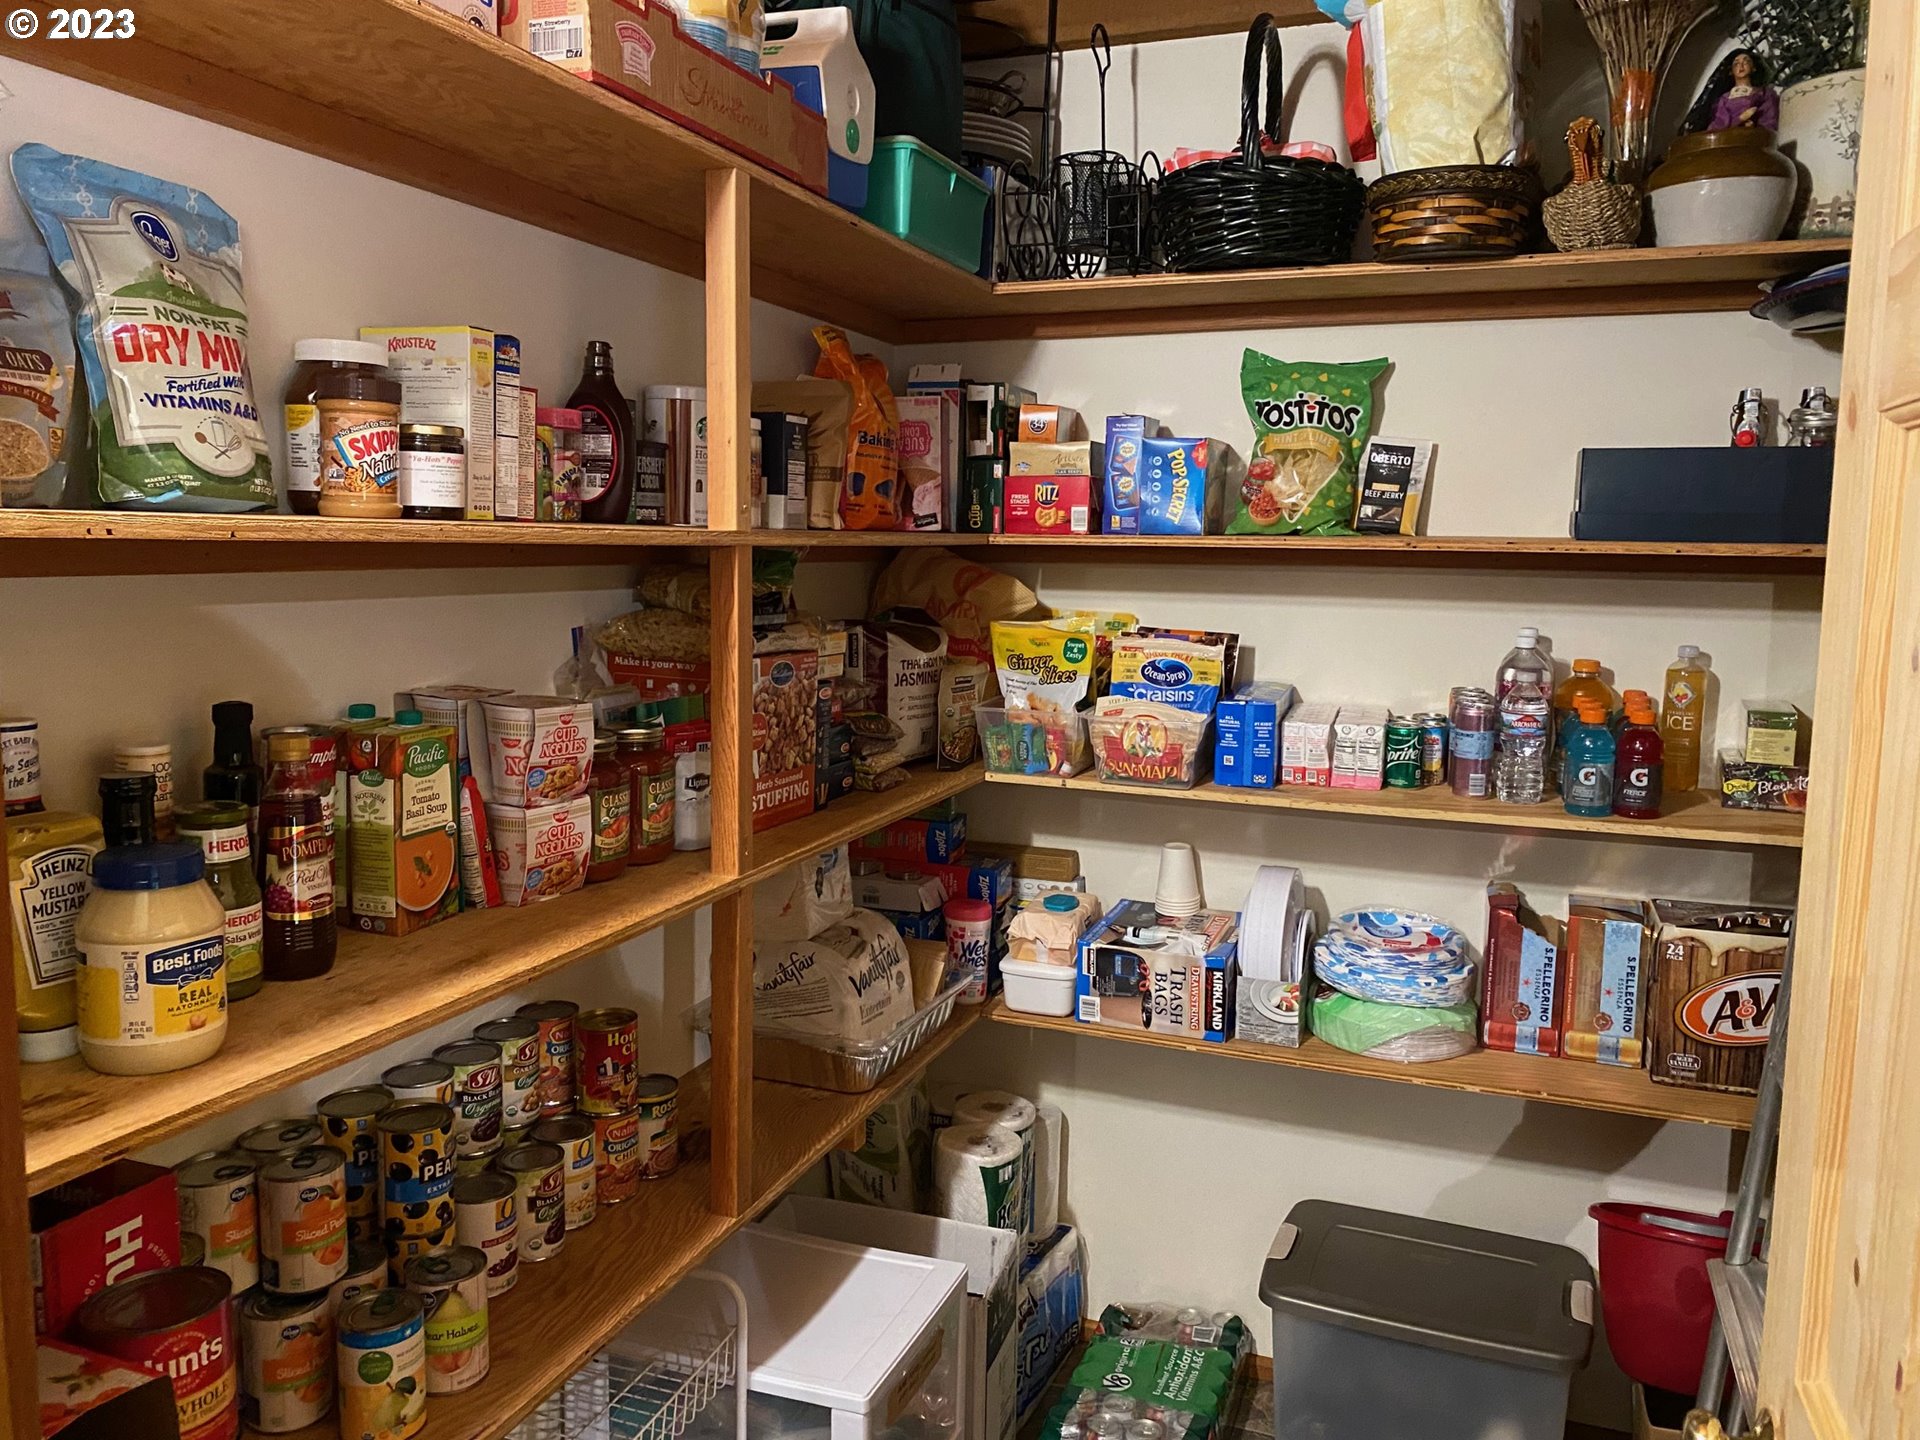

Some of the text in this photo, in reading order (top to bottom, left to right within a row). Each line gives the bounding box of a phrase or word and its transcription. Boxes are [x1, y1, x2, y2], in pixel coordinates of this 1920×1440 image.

[152, 305, 231, 333] NON-FAT
[112, 323, 189, 367] DRY
[387, 336, 437, 352] KRUSTEAZ
[7, 351, 46, 371] OATS
[166, 377, 222, 394] Fortified
[144, 392, 259, 422] VITAMINS A&D
[338, 430, 351, 438] No
[350, 424, 369, 435] Need
[1273, 433, 1335, 447] HINT LIME
[347, 431, 399, 460] SKIPP
[858, 430, 896, 451] Baking
[695, 450, 708, 460] Ho
[1370, 452, 1412, 466] OBERTO
[637, 456, 665, 474] ERSHEY'S
[639, 474, 660, 489] COCOA
[1166, 447, 1191, 526] POP SECRET
[1034, 484, 1060, 502] RITZ
[1363, 488, 1405, 501] BEEF JERKY
[968, 504, 982, 529] CLUB
[1066, 640, 1086, 649] Sweet
[614, 656, 697, 672] Make it your way
[900, 658, 921, 670] THAI
[1007, 653, 1053, 673] Ginger
[1066, 651, 1083, 661] Zesty
[894, 669, 940, 687] JASMINE
[1038, 666, 1079, 687] Slices
[1143, 666, 1188, 684] Ocean Spray
[1132, 686, 1196, 704] Craisins
[1510, 718, 1543, 730] ARROWHEA
[1667, 715, 1695, 731] ICE
[553, 726, 579, 741] CUP
[407, 744, 445, 768] Pacific
[539, 739, 587, 758] NOODLES
[17, 755, 39, 771] Sauc
[151, 762, 171, 774] 100
[1108, 759, 1178, 780] SUN-MAID
[8, 774, 25, 789] the
[756, 771, 804, 792] Herb Seasoned
[1579, 767, 1597, 786] G
[1630, 768, 1649, 787] G
[355, 790, 386, 804] NOURISH
[1757, 780, 1796, 796] Black
[411, 792, 440, 806] Tomato
[406, 802, 448, 820] Basil Soup
[547, 822, 575, 839] CUP
[534, 833, 584, 859] NOODLES
[935, 828, 947, 857] Ziploc
[40, 857, 86, 880] HEINZ
[286, 867, 317, 889] Red
[40, 881, 86, 902] YELLOW
[32, 893, 90, 919] MUSTAR
[225, 933, 248, 945] Salsa
[960, 940, 988, 957] Wet
[1667, 943, 1685, 957] 24
[152, 943, 223, 974] Best Foods
[1666, 954, 1684, 962] PACK
[1534, 968, 1542, 999] ESSENZA
[1539, 947, 1554, 1022] S.PELLEGRINO
[178, 986, 213, 1004] REAL
[1154, 972, 1169, 1016] BAGS
[1169, 966, 1187, 1026] TRASH
[1190, 966, 1200, 1030] DRAWSTRING
[1212, 970, 1224, 1031] KIRKLAND
[1615, 978, 1624, 1010] ESSENZA
[1621, 956, 1637, 1033] S.PELLEGRINO
[1669, 1060, 1699, 1069] VANILLA
[462, 1093, 488, 1103] BLACK
[535, 1195, 558, 1208] BLACK
[295, 1223, 329, 1243] Sliced
[446, 1322, 480, 1340] Halves
[154, 1337, 224, 1380] unts
[1114, 1346, 1131, 1373] origina
[1152, 1348, 1179, 1396] Excellent Source
[1163, 1345, 1192, 1400] Antioxidan
[1176, 1348, 1206, 1401] Vitamins A&C
[1102, 1374, 1131, 1390] V8
